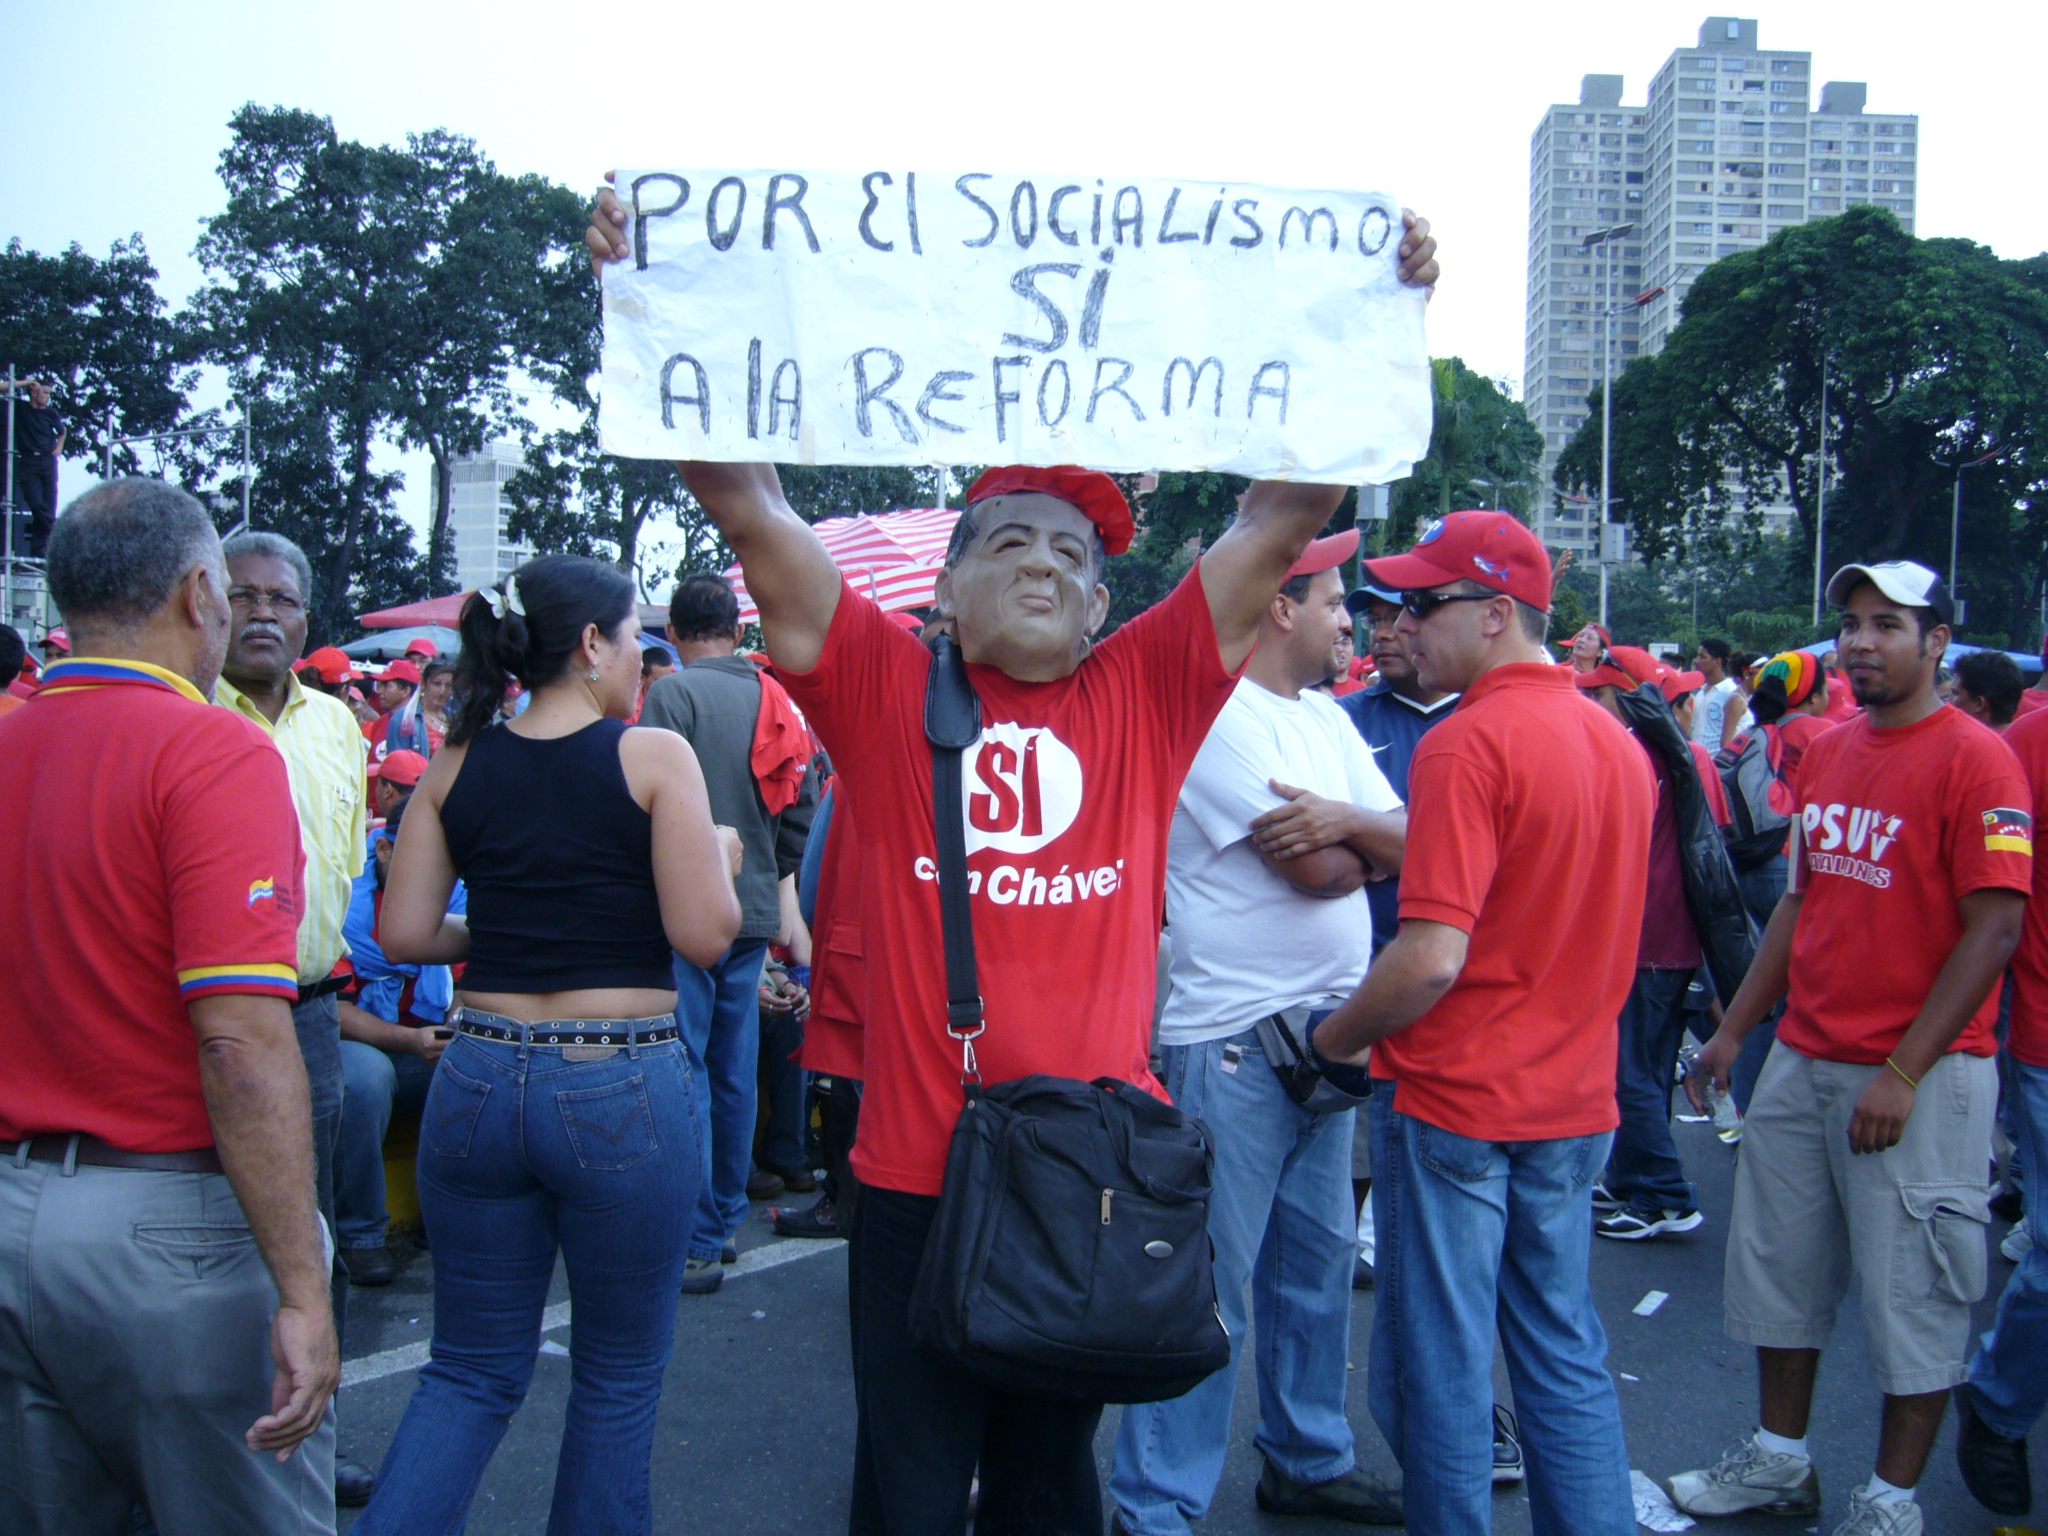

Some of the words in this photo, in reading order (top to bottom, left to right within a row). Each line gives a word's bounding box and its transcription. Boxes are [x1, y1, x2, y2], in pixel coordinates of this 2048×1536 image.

[631, 172, 822, 271] POR
[659, 352, 711, 435] A
[844, 346, 1291, 446] REFORMA
[1802, 803, 1902, 862] PSUV
[914, 856, 982, 894] cn
